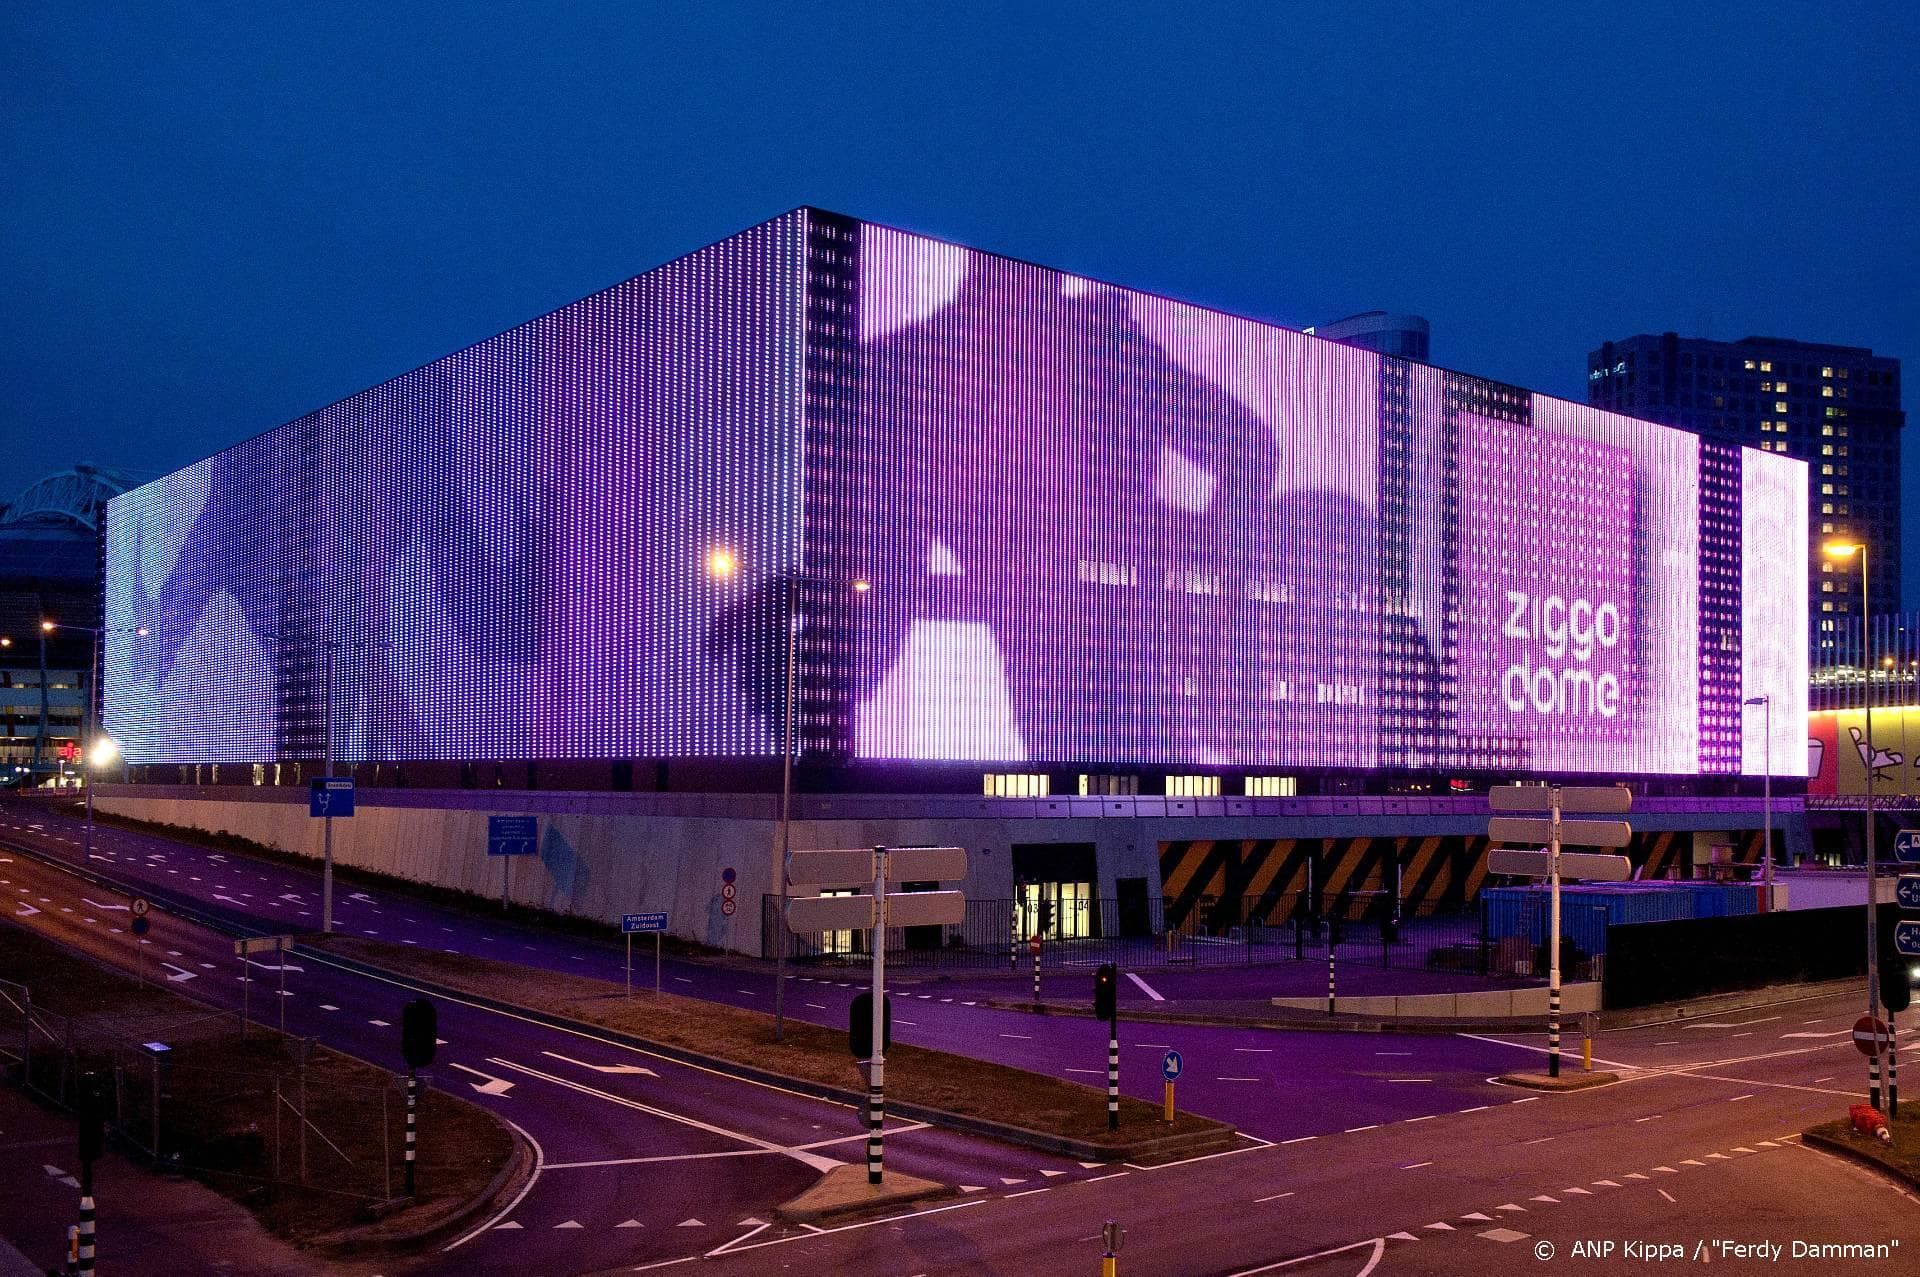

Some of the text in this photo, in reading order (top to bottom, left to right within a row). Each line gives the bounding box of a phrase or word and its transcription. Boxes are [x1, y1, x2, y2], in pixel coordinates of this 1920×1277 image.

[1503, 591, 1619, 662] ziggo
[1502, 650, 1619, 717] dome
[627, 914, 664, 922] Amsterdam
